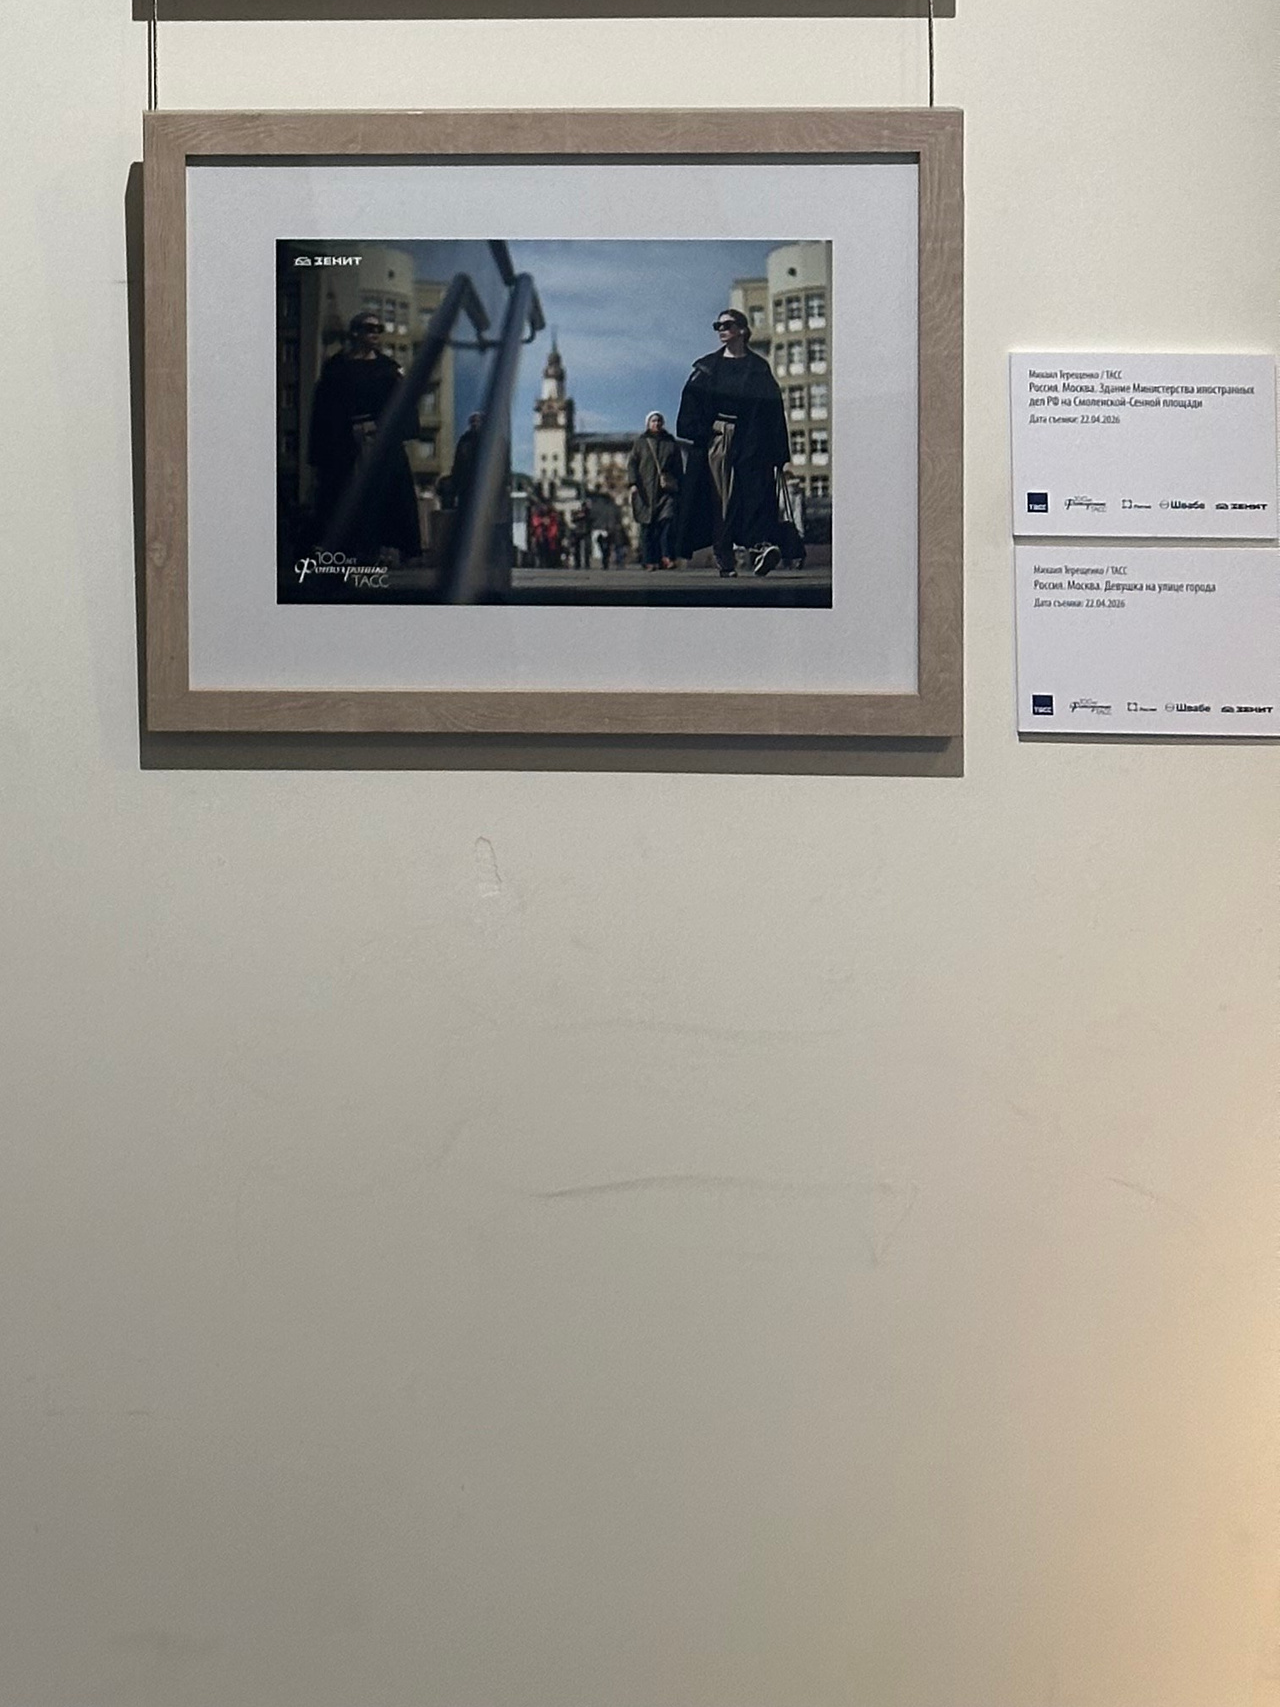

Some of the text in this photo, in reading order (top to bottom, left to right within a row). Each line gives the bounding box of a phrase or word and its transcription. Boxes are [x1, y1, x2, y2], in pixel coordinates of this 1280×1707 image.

[313, 256, 362, 266] ЗЕНИТ
[1029, 370, 1058, 379] Михаил
[1059, 370, 1100, 381] Терещенко
[1106, 370, 1122, 379] ТАСС
[1098, 383, 1131, 395] Здание
[1132, 383, 1195, 396] Министерства
[1196, 385, 1255, 397] иностранных
[1029, 396, 1203, 409] дел РФ на Смоленской-Сенной площади
[1029, 414, 1047, 425] Дата
[1079, 414, 1120, 424] 22.04.2026
[1170, 500, 1206, 510] Швабе
[315, 551, 346, 565] 100
[1033, 565, 1063, 574] Михаил
[1064, 565, 1104, 577] Терещенко
[1111, 566, 1128, 575] ТАСС
[351, 574, 390, 588] ТАСС
[1104, 580, 1144, 594] Девушка
[1145, 583, 1156, 591] на
[1157, 583, 1184, 594] улице
[1185, 583, 1216, 594] города
[1033, 598, 1052, 608] Дата
[1084, 598, 1126, 608] 22.04.2026
[1175, 703, 1211, 712] Швабе
